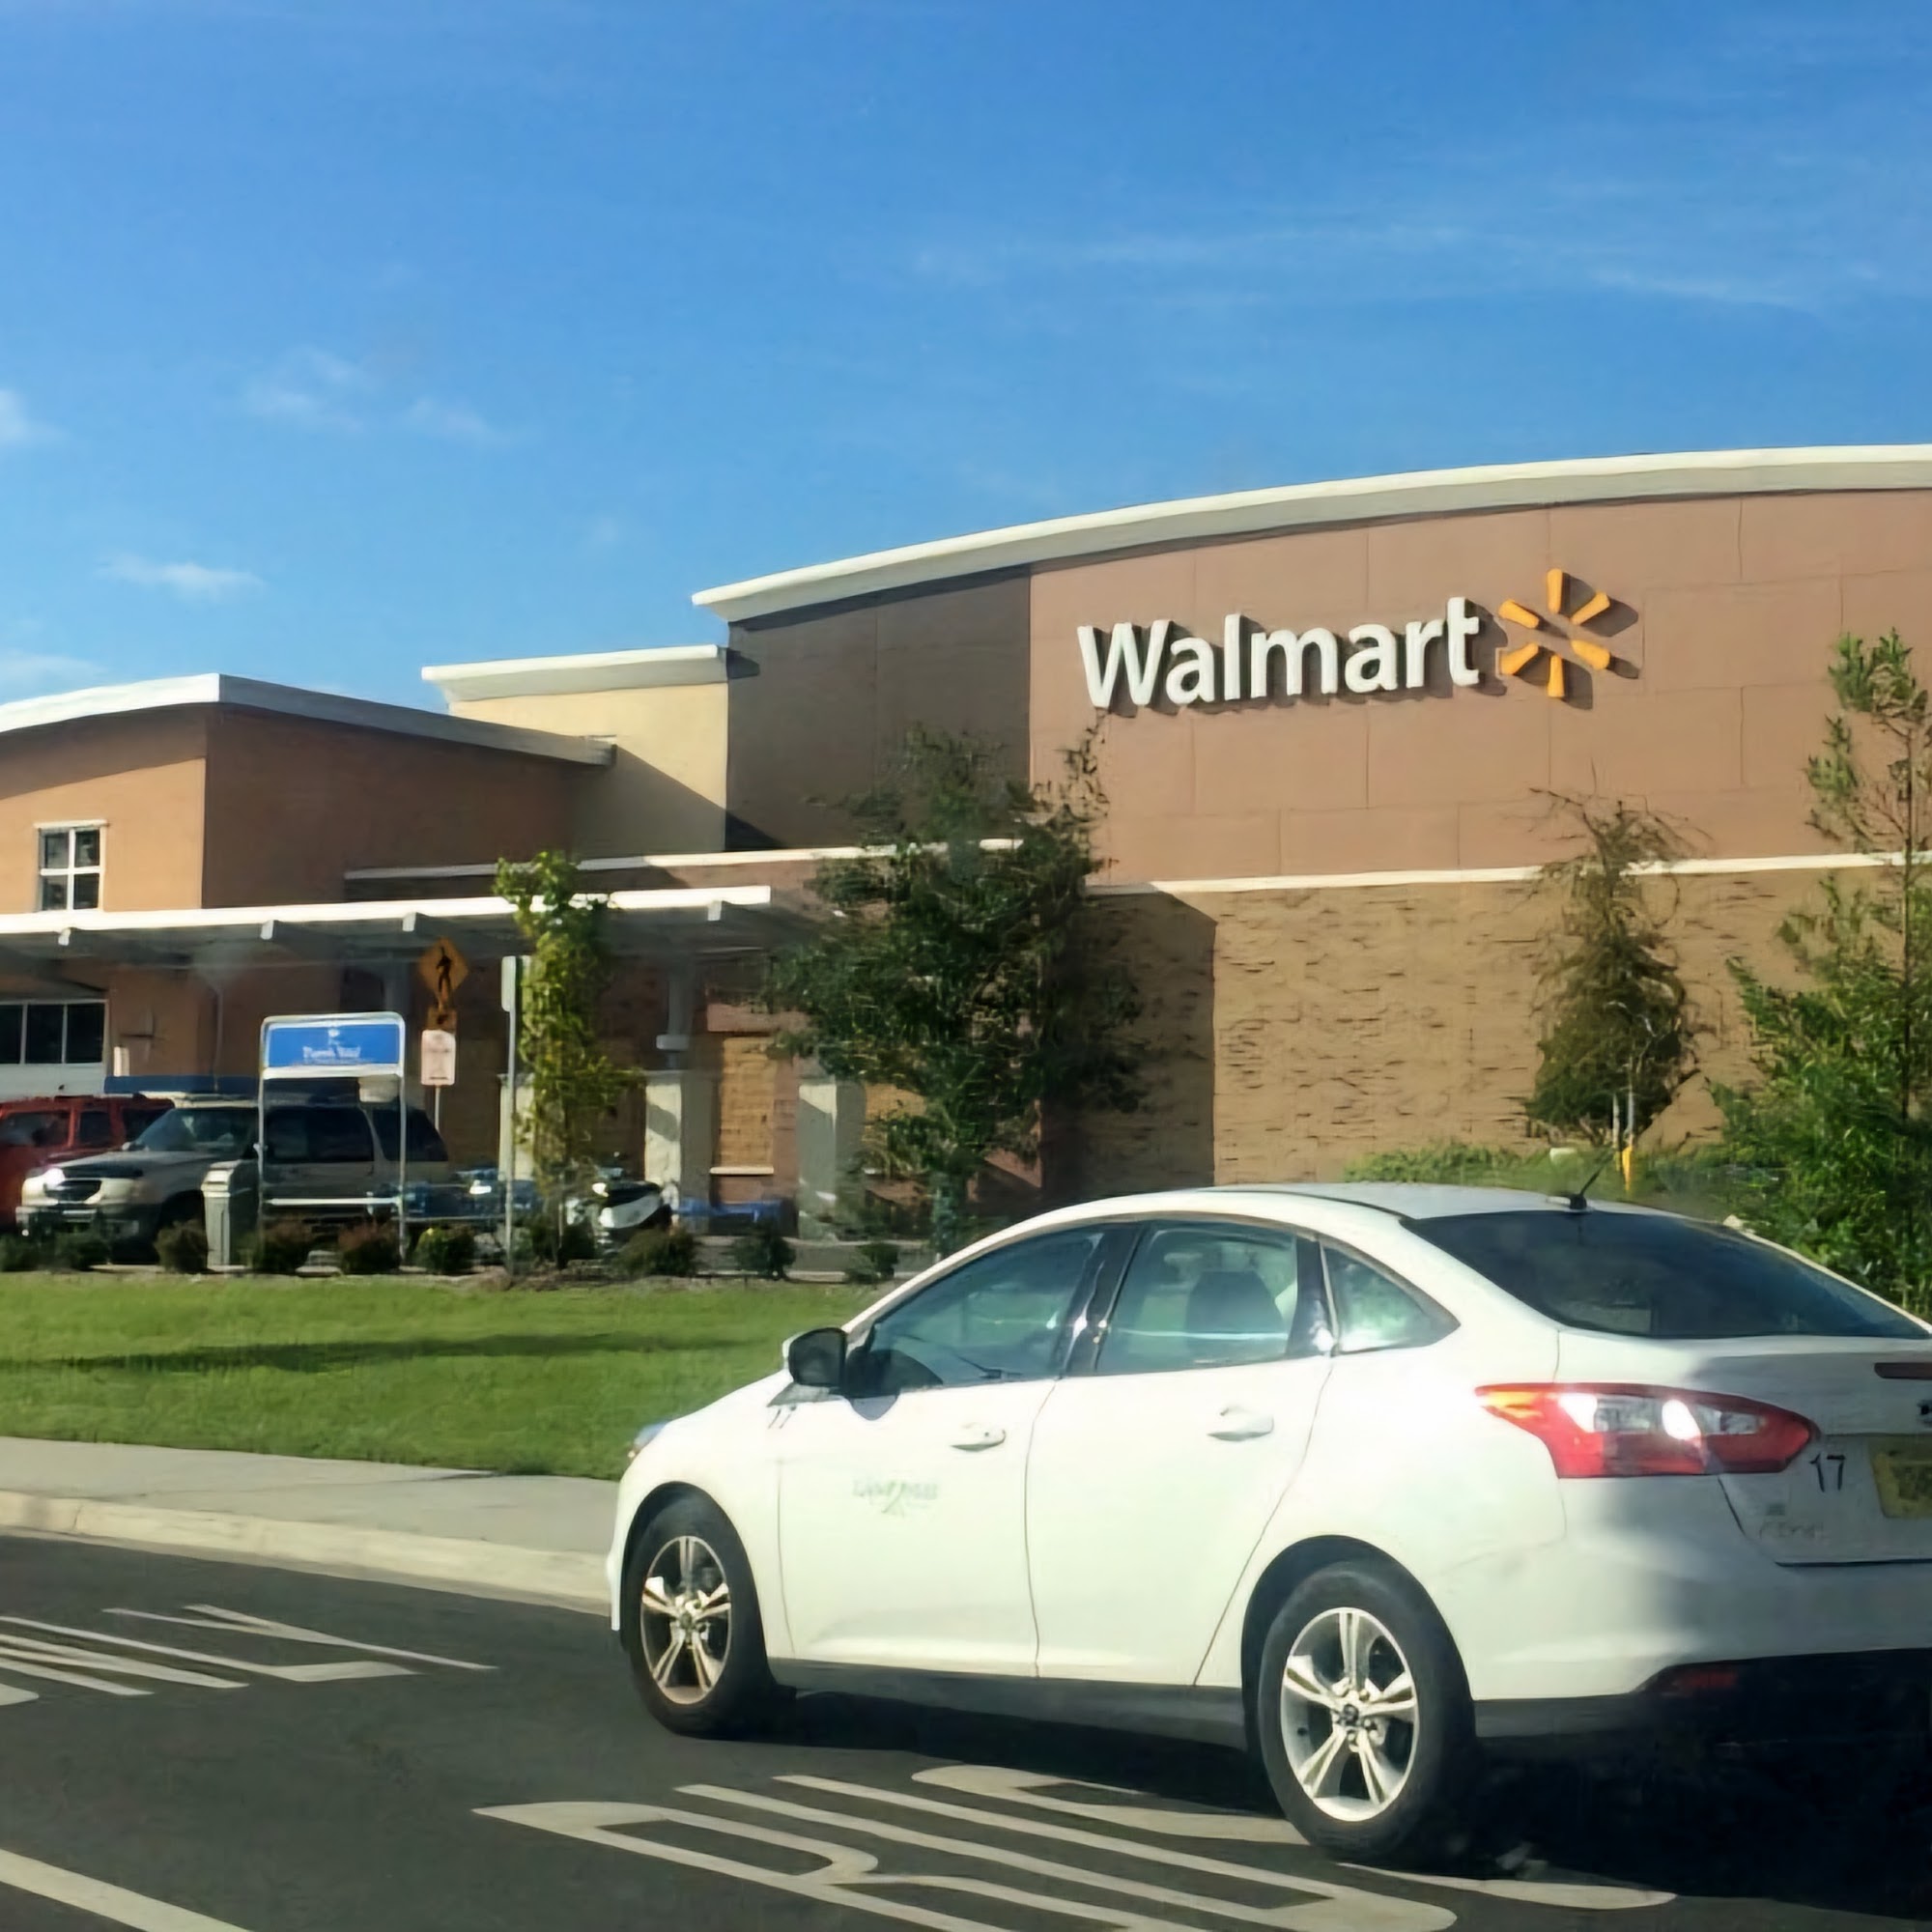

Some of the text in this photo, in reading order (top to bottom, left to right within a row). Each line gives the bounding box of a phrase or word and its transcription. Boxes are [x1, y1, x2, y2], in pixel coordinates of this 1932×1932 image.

[1076, 596, 1481, 709] Walmart
[1809, 1452, 1846, 1493] 17
[0, 1604, 499, 1707] NLY
